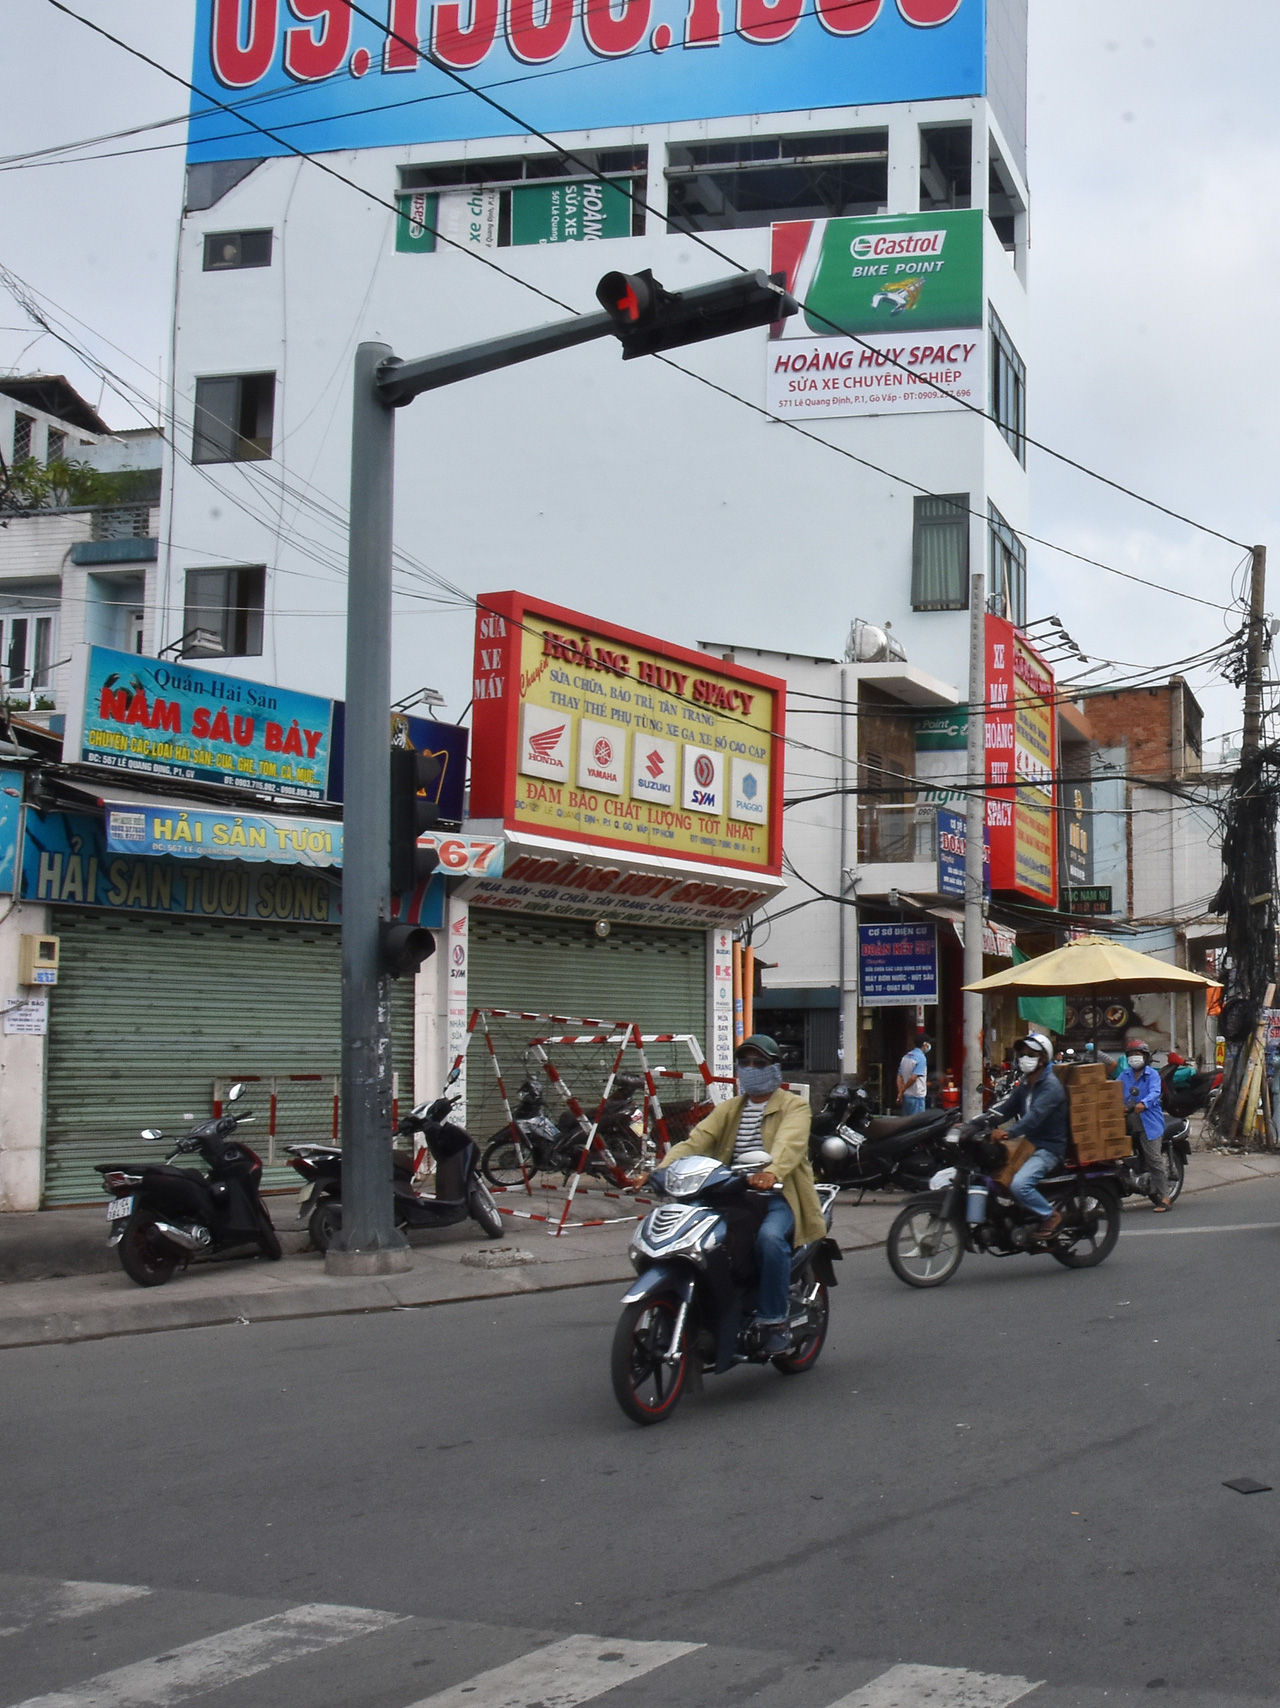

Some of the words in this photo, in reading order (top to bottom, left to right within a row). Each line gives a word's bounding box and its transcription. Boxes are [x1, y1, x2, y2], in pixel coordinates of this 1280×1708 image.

[551, 190, 560, 204] 567
[565, 185, 580, 215] SỬA
[469, 221, 482, 243] xe
[565, 217, 577, 236] XE
[873, 233, 939, 256] Castrol
[852, 264, 889, 278] BIKE
[894, 260, 945, 275] POINT
[774, 348, 854, 374] HOÀNG
[858, 347, 906, 368] HUY
[908, 343, 977, 366] SPACY
[788, 374, 818, 392] SỬA
[822, 376, 839, 389] XE
[843, 372, 903, 389] CHUYÊN
[906, 368, 962, 387] NGHIỆP
[779, 399, 793, 407] 571
[805, 397, 831, 408] Quang
[869, 393, 880, 404] Gò
[480, 648, 502, 671] XE
[993, 644, 1005, 669] XE
[541, 630, 631, 678] HOÀNG
[638, 660, 689, 697] HUY
[692, 678, 755, 716] SPACY
[474, 672, 505, 700] MÁY
[550, 667, 571, 687] SỬA
[682, 706, 715, 727] TRANG
[990, 677, 1008, 709] MÁY
[191, 705, 255, 747] SÁU
[550, 690, 580, 710] THAY
[635, 712, 663, 734] TÙNG
[666, 722, 679, 736] XE
[681, 727, 696, 741] GA
[699, 731, 712, 746] XE
[729, 740, 746, 755] CAO
[922, 719, 950, 730] Point
[985, 716, 1014, 749] HOÀNG
[88, 729, 129, 752] CHUYÊN
[130, 736, 151, 756] CÁC
[127, 759, 153, 772] QUANG
[528, 752, 565, 768] HONDA
[587, 767, 618, 783] YAMAHA
[991, 761, 1009, 785] HUY
[637, 778, 671, 794] SUZUKI
[691, 790, 716, 807] SYM
[736, 799, 763, 813] PIAGGIO
[987, 801, 1013, 826] SPACY
[152, 812, 203, 843] HẢI
[211, 818, 267, 848] SẢN
[274, 828, 332, 853] TƯƠI
[37, 835, 98, 902] HẢI
[502, 853, 621, 892] HOÀNG
[610, 870, 685, 899] HUY
[671, 879, 768, 911] SPACY
[474, 880, 499, 892] MUA
[614, 898, 651, 911] TRANG
[1080, 889, 1098, 901] NAM
[450, 968, 466, 978] SYM
[715, 1063, 732, 1071] TRANG
